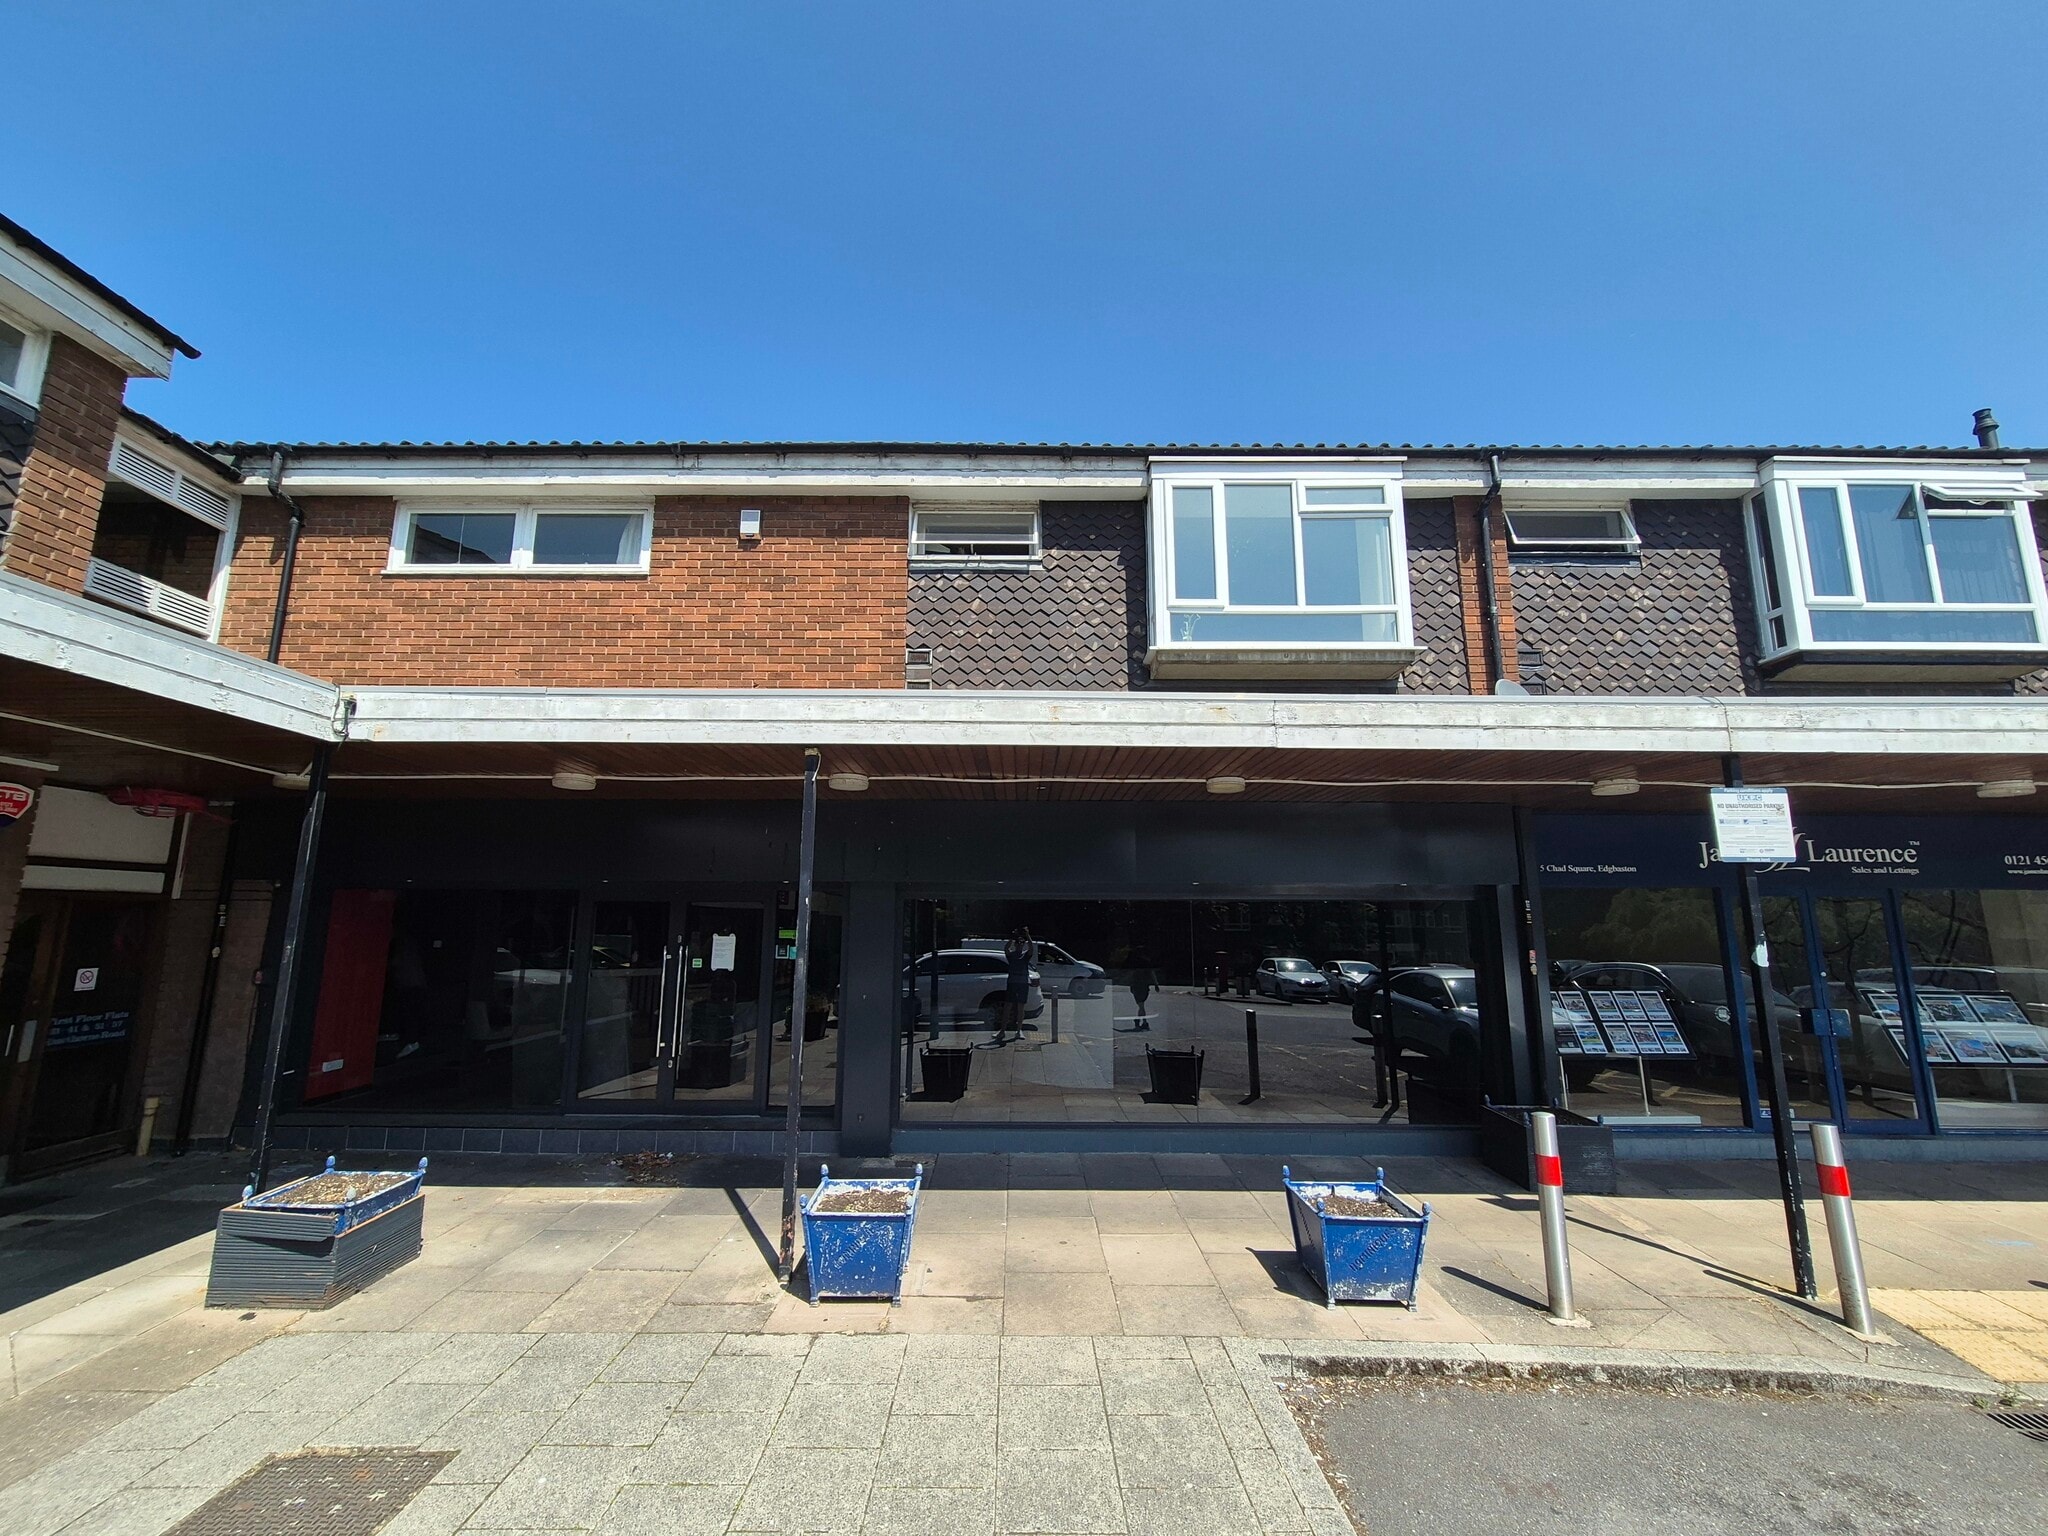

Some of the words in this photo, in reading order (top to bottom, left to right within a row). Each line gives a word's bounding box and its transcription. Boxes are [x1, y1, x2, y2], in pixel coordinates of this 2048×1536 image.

[1804, 840, 1918, 863] Laurence
[2004, 855, 2031, 865] 0121
[2033, 855, 2048, 865] 45
[1568, 865, 1596, 874] Square,
[1598, 865, 1637, 874] Edgbaston
[1851, 866, 1872, 874] Sales
[1873, 866, 1887, 874] and
[1889, 866, 1920, 875] Lettings
